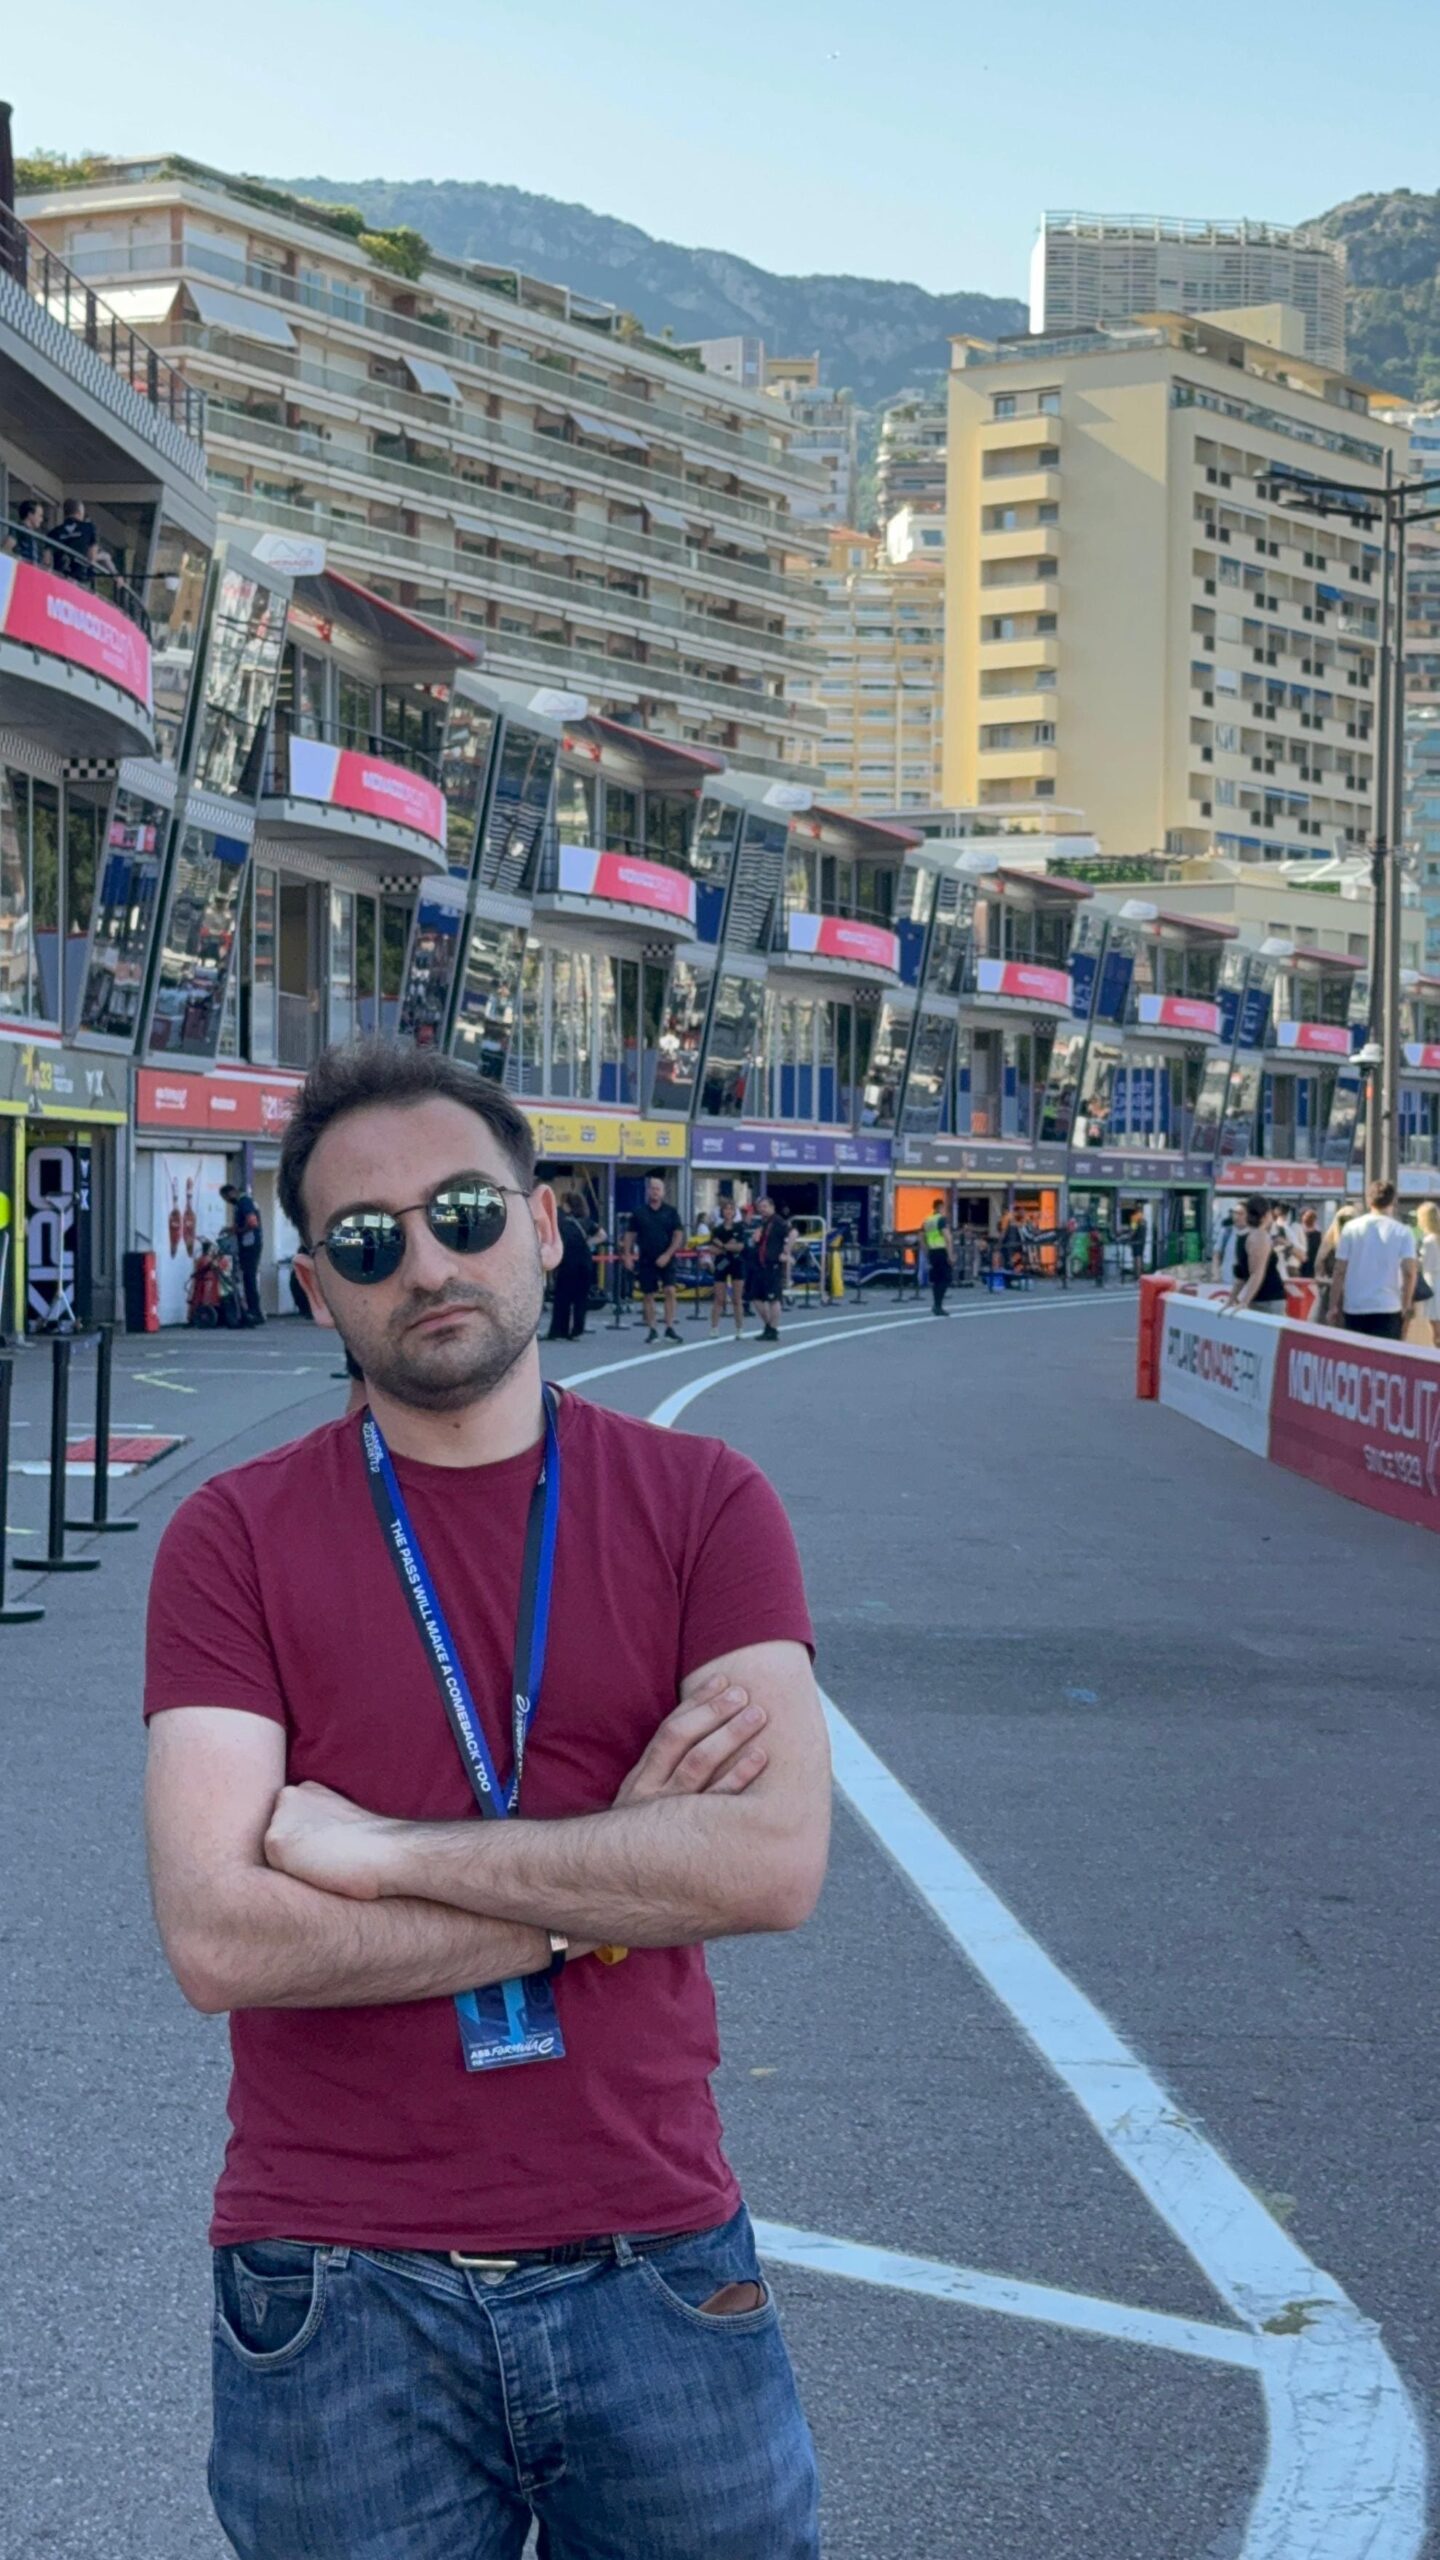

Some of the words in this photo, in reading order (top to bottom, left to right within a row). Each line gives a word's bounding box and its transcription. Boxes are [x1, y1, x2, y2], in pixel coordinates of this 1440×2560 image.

[390, 1518, 408, 1548] THE
[400, 1547, 421, 1585] PASS
[412, 1584, 433, 1620] WILL
[425, 1620, 450, 1663] MAKE
[441, 1664, 453, 1676] A
[446, 1677, 482, 1761] COMEBACK
[474, 1761, 492, 1793] TOO
